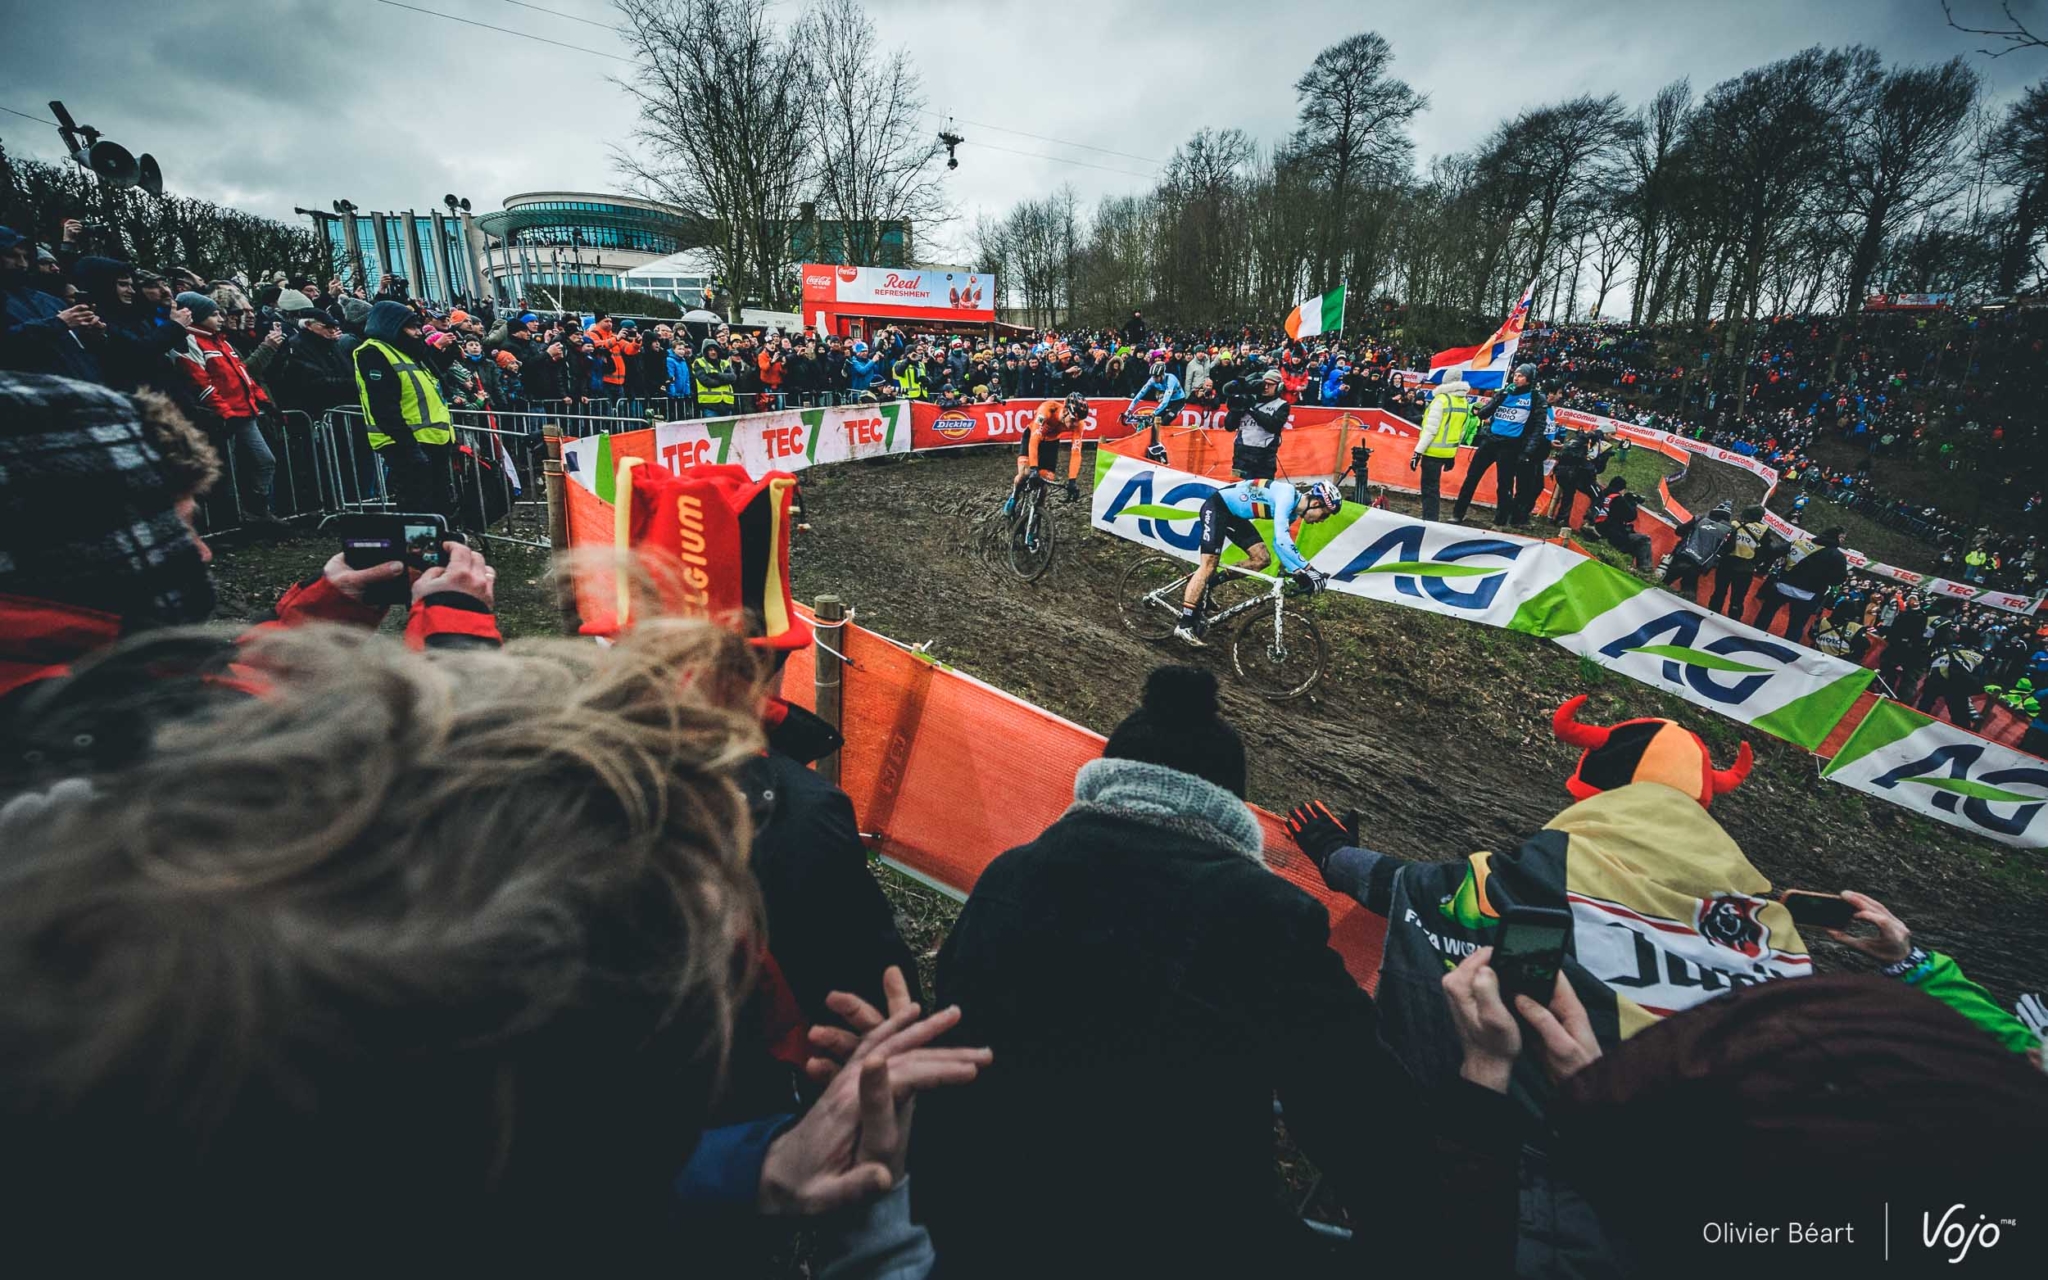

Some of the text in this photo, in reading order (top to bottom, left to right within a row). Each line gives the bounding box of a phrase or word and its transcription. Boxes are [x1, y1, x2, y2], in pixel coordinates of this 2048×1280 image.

[875, 289, 931, 298] REFRESHMENT
[884, 273, 921, 289] Real
[1330, 525, 1524, 609] AG
[1598, 609, 1802, 705] AG
